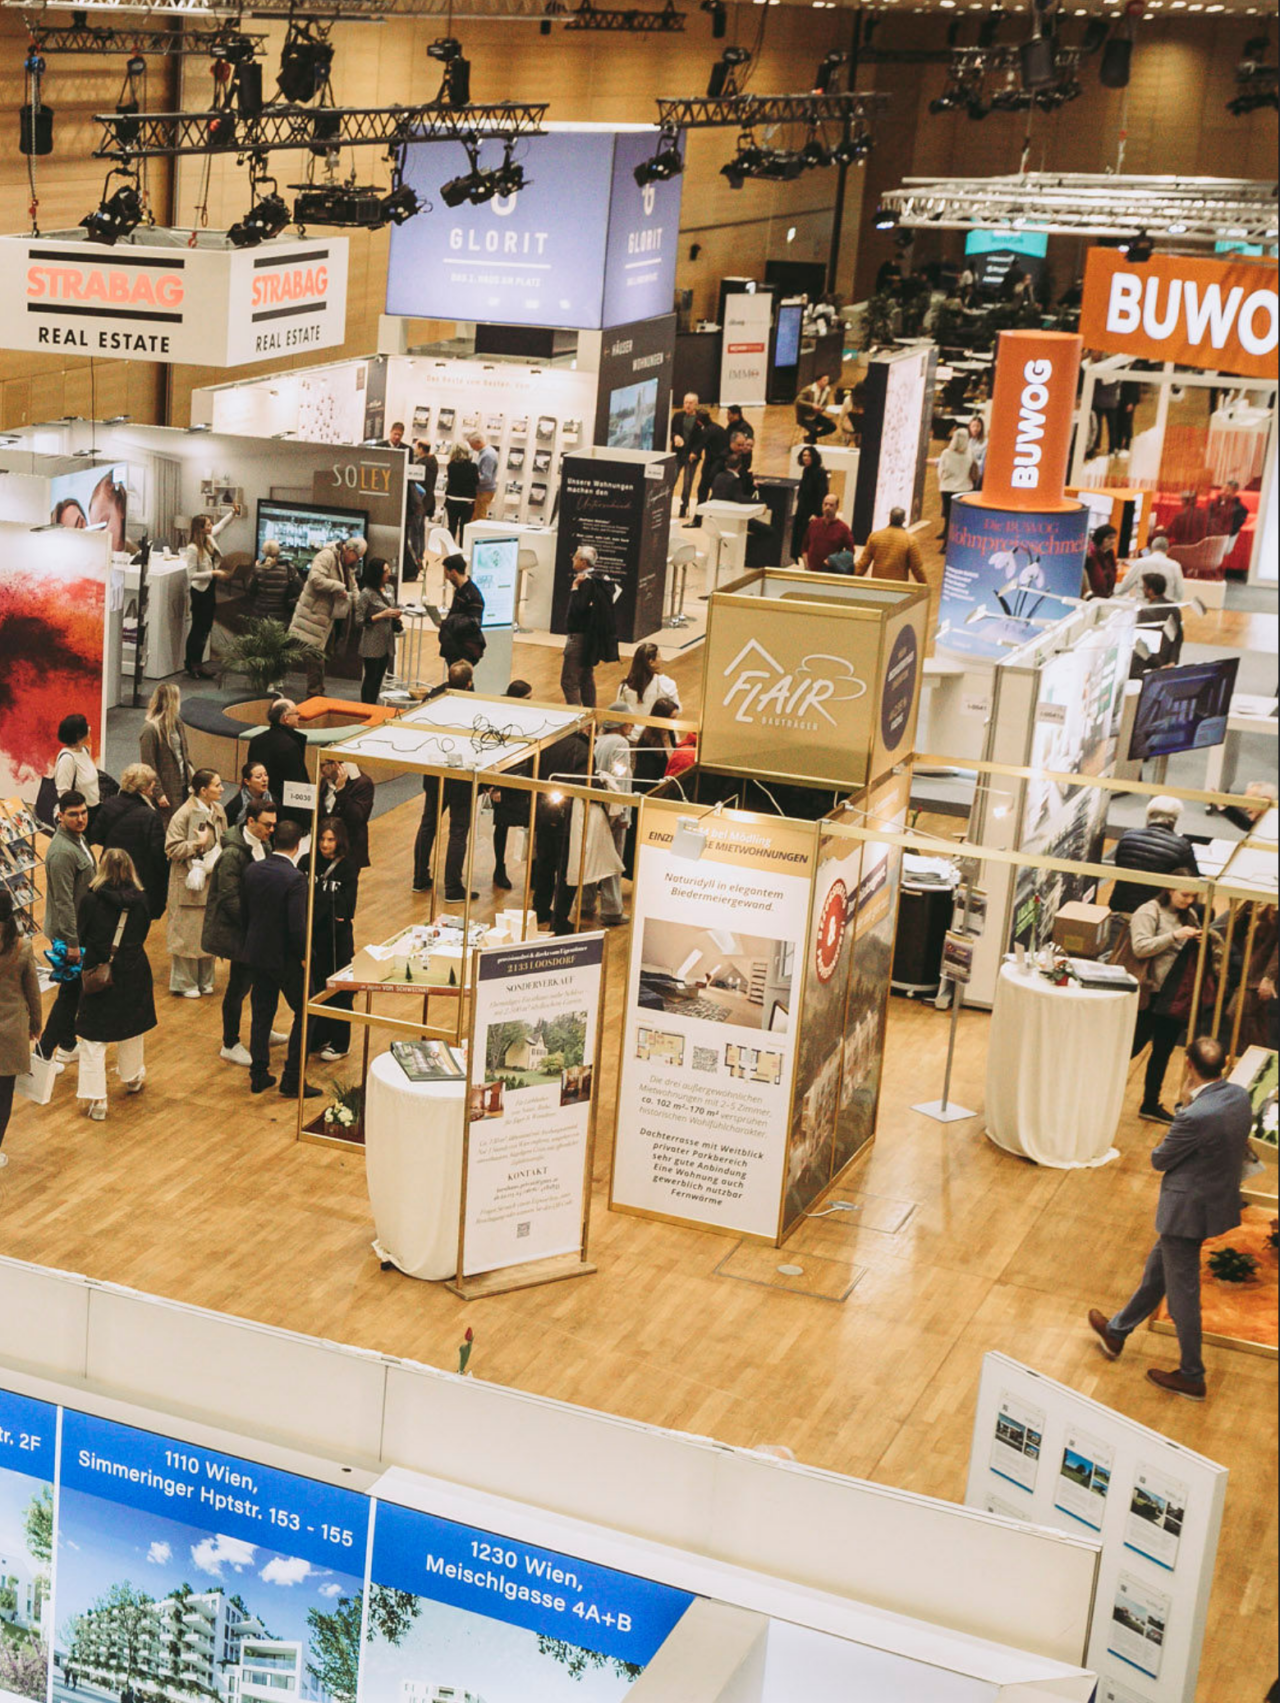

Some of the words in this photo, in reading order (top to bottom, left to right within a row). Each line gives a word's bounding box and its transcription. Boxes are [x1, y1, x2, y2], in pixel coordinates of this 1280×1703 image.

[449, 227, 549, 255] GLORIT
[627, 228, 663, 255] GLORIT
[26, 266, 185, 308] STRABAG
[251, 265, 328, 307] STRABAG
[1106, 272, 1279, 356] BUWO
[38, 326, 89, 347] REAL
[98, 331, 171, 353] ESTATE
[256, 334, 282, 353] REAL
[286, 324, 321, 350] ESTATE
[1011, 359, 1053, 489] BUWOG
[332, 464, 391, 491] SOLEY
[567, 477, 591, 488] Unsere
[593, 480, 634, 491] Wohnungen
[567, 486, 593, 496] machen
[595, 488, 609, 497] den
[723, 671, 837, 727] FLAIR
[761, 716, 818, 731] BAUTRÄGER
[730, 829, 772, 847] Mödling
[715, 842, 809, 864] MIETWOHNUNGEN
[664, 872, 716, 889] Naturidyll
[717, 880, 727, 890] in
[729, 884, 784, 900] elegantem
[670, 887, 774, 912] Biedermeiergewand.
[507, 964, 529, 973] 2133
[529, 955, 576, 970] LOOSDORF
[506, 976, 574, 992] SONDERVERKAUF
[639, 1083, 703, 1104] Mietwohnungen
[705, 1096, 719, 1107] mit
[649, 1074, 663, 1084] Die
[665, 1077, 681, 1088] drei
[682, 1081, 763, 1104] außergewöhnlichen
[639, 1105, 687, 1123] historischen
[641, 1096, 654, 1105] ca.
[656, 1098, 671, 1108] 102
[720, 1112, 768, 1128] versprühen
[639, 1127, 699, 1147] Dachterrasse
[701, 1140, 718, 1151] mit
[720, 1144, 764, 1160] Weitblick
[652, 1141, 690, 1156] privater
[692, 1149, 748, 1168] Parkbereich
[507, 1167, 549, 1181] KONTAKT
[652, 1152, 672, 1163] sehr
[674, 1158, 695, 1169] gute
[697, 1162, 747, 1180] Anbindung
[653, 1163, 673, 1173] Eine
[675, 1168, 718, 1185] Wohnung
[721, 1177, 744, 1189] auch
[652, 1174, 704, 1191] gewerblich
[705, 1185, 743, 1199] nutzbar
[670, 1188, 723, 1206] Fernwärme
[19, 1433, 42, 1452] 2F
[165, 1451, 199, 1474] 1110
[205, 1461, 259, 1494] Wien,
[78, 1450, 195, 1499] Simmeringer
[200, 1487, 263, 1520] Hptstr.
[269, 1508, 300, 1531] 153
[320, 1523, 353, 1547] 155
[471, 1541, 518, 1569] 1230
[524, 1556, 584, 1593] Wien,
[426, 1554, 566, 1612] Meischlgasse
[572, 1601, 632, 1633] 4A+B
